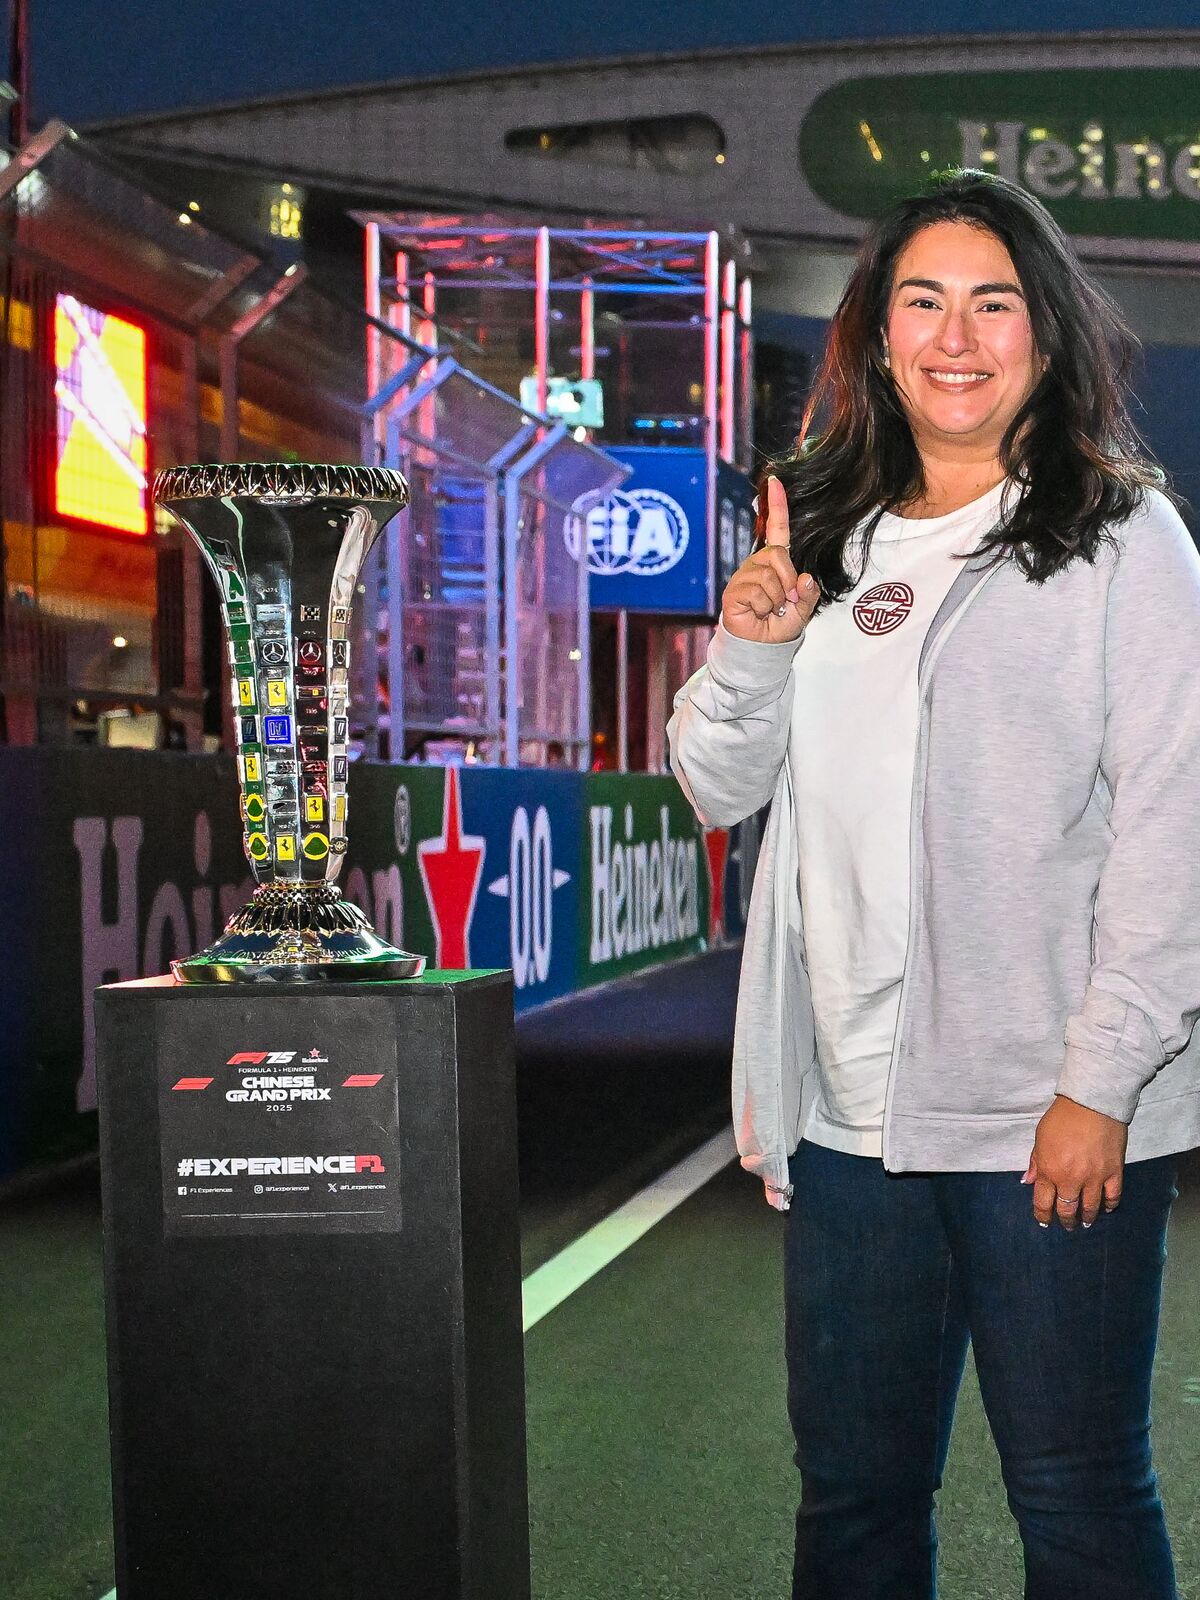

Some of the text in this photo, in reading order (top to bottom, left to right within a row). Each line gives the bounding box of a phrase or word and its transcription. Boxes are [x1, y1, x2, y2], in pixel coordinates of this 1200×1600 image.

[589, 802, 700, 964] Heineken
[241, 1075, 315, 1089] CHINESE
[225, 1087, 332, 1103] GRAND PRIX
[266, 1104, 293, 1112] 2025
[177, 1154, 385, 1177] #EXPERIENCEF1
